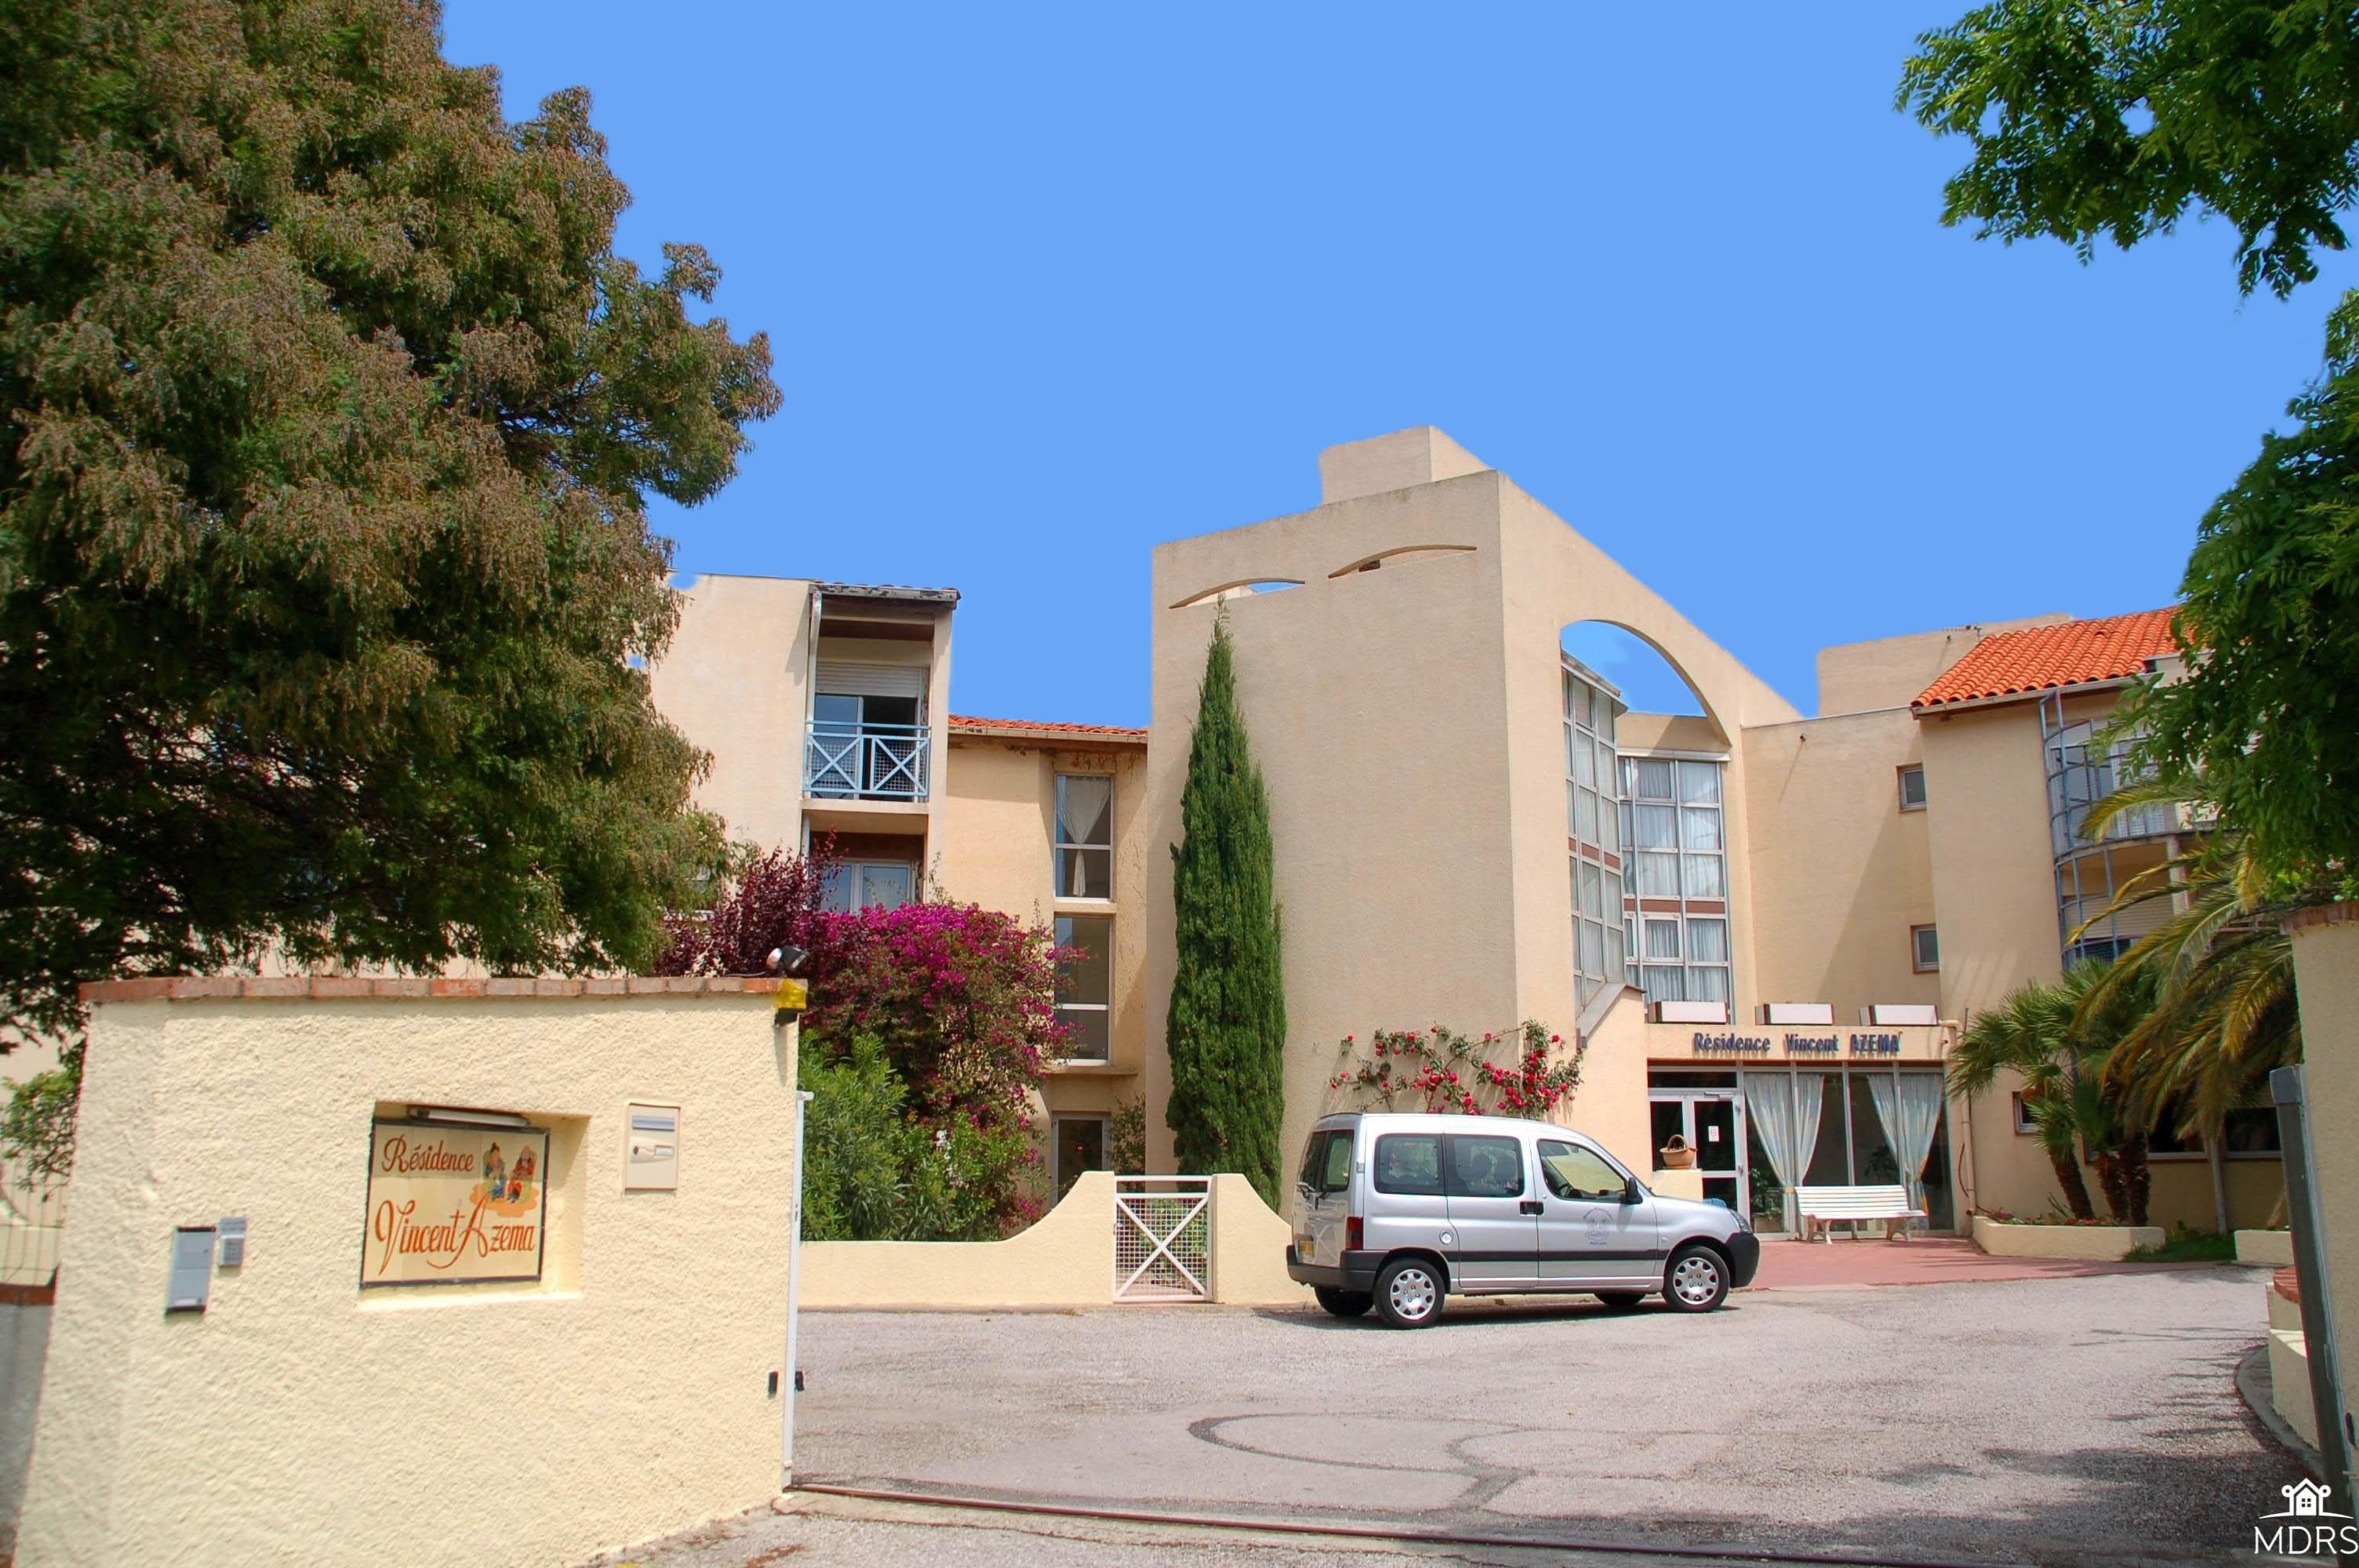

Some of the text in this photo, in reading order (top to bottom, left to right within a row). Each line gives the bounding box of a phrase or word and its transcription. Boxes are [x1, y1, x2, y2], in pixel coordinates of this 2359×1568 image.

[1693, 1032, 1899, 1052] Résidence Vincent AZEMA
[381, 1134, 474, 1174] Résidence
[375, 1192, 535, 1276] Vincent Azema
